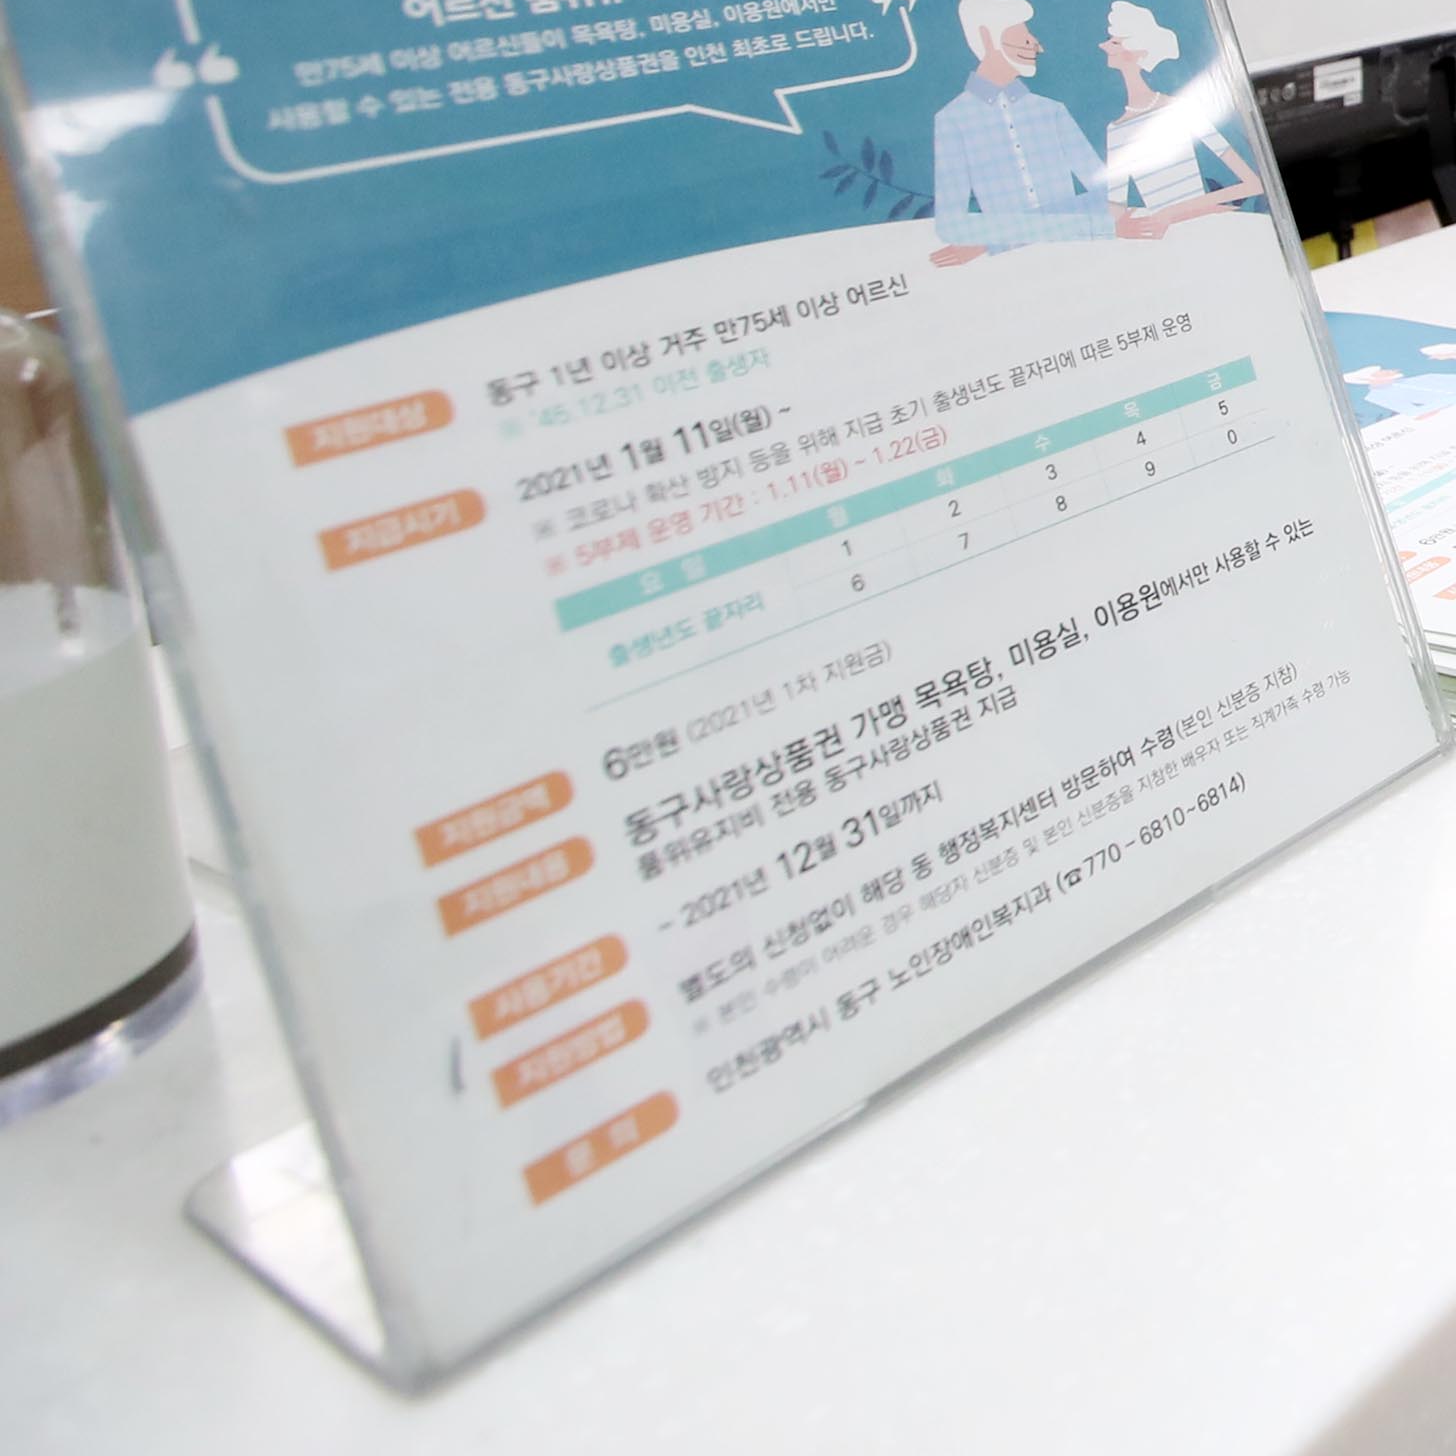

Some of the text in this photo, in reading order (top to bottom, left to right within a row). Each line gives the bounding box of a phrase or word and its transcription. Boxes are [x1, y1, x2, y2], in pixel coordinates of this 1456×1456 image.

[390, 45, 442, 71] 이상
[447, 27, 565, 62] 어르신들이
[571, 19, 646, 46] 목욕탕,
[649, 8, 720, 34] 미용실,
[503, 48, 680, 97] 동구사랑상품권을
[684, 41, 728, 68] 인천
[732, 32, 791, 60] 최초로
[795, 20, 874, 49] 드립니다.
[485, 273, 910, 408] 동구 1년 이상 거주 만75세 이상 어르신
[652, 368, 699, 396] 이전
[706, 348, 771, 385] 출생자
[516, 405, 772, 502] 2021년 1월 11일(월)
[565, 494, 638, 531] 코로나
[699, 461, 743, 490] 방지
[748, 447, 791, 475] 등을
[797, 427, 840, 455] 위해
[845, 411, 885, 440] 지급
[889, 397, 927, 426] 초기
[932, 374, 1005, 414] 출생년도
[1009, 351, 1077, 389] 끝자리에
[1079, 338, 1113, 363] 따른
[1116, 324, 1160, 352] 5부제
[1161, 312, 1193, 338] 운영
[647, 510, 694, 545] 운영
[700, 494, 745, 523] 기간
[767, 460, 849, 501] 1.11(월)
[872, 424, 949, 465] 1.22(금)
[841, 400, 1230, 556] 1 2 3 4 5
[1035, 436, 1052, 452] 수
[850, 429, 1238, 592] 6 7 8 9 0
[601, 639, 893, 781] 6만원 (2021년 1차 지원금)
[624, 517, 1315, 847] 동구사랑상품권 가맹 목욕탕, 미용실, 이용원에서만 사용할 수 있는
[637, 684, 1019, 882] 품위유지비 전용 동구사랑상품권 지급
[677, 945, 757, 1004] 별도의
[762, 894, 856, 960] 신청없이
[860, 866, 907, 904] 해당
[910, 851, 933, 881] 동
[938, 785, 1058, 866] 행정복지센터
[1061, 745, 1137, 800] 방문하여
[1215, 683, 1261, 718] 신분증
[1264, 661, 1299, 691] 지참)
[973, 846, 1020, 884] 신분증
[1023, 834, 1040, 855] 및
[1043, 818, 1074, 847] 본인
[1076, 784, 1135, 830] 신분증을
[1138, 758, 1179, 792] 지참한
[1181, 737, 1222, 769] 배우자
[1222, 725, 1249, 746] 또는
[1251, 695, 1300, 731] 직계가족
[1302, 681, 1327, 704] 수령
[1327, 668, 1352, 688] 가능
[680, 779, 944, 928] 2021년 12월 31일까지
[705, 1005, 831, 1095] 인천광역시
[835, 977, 881, 1021] 동구
[887, 880, 1053, 991] 노인장애인복지과
